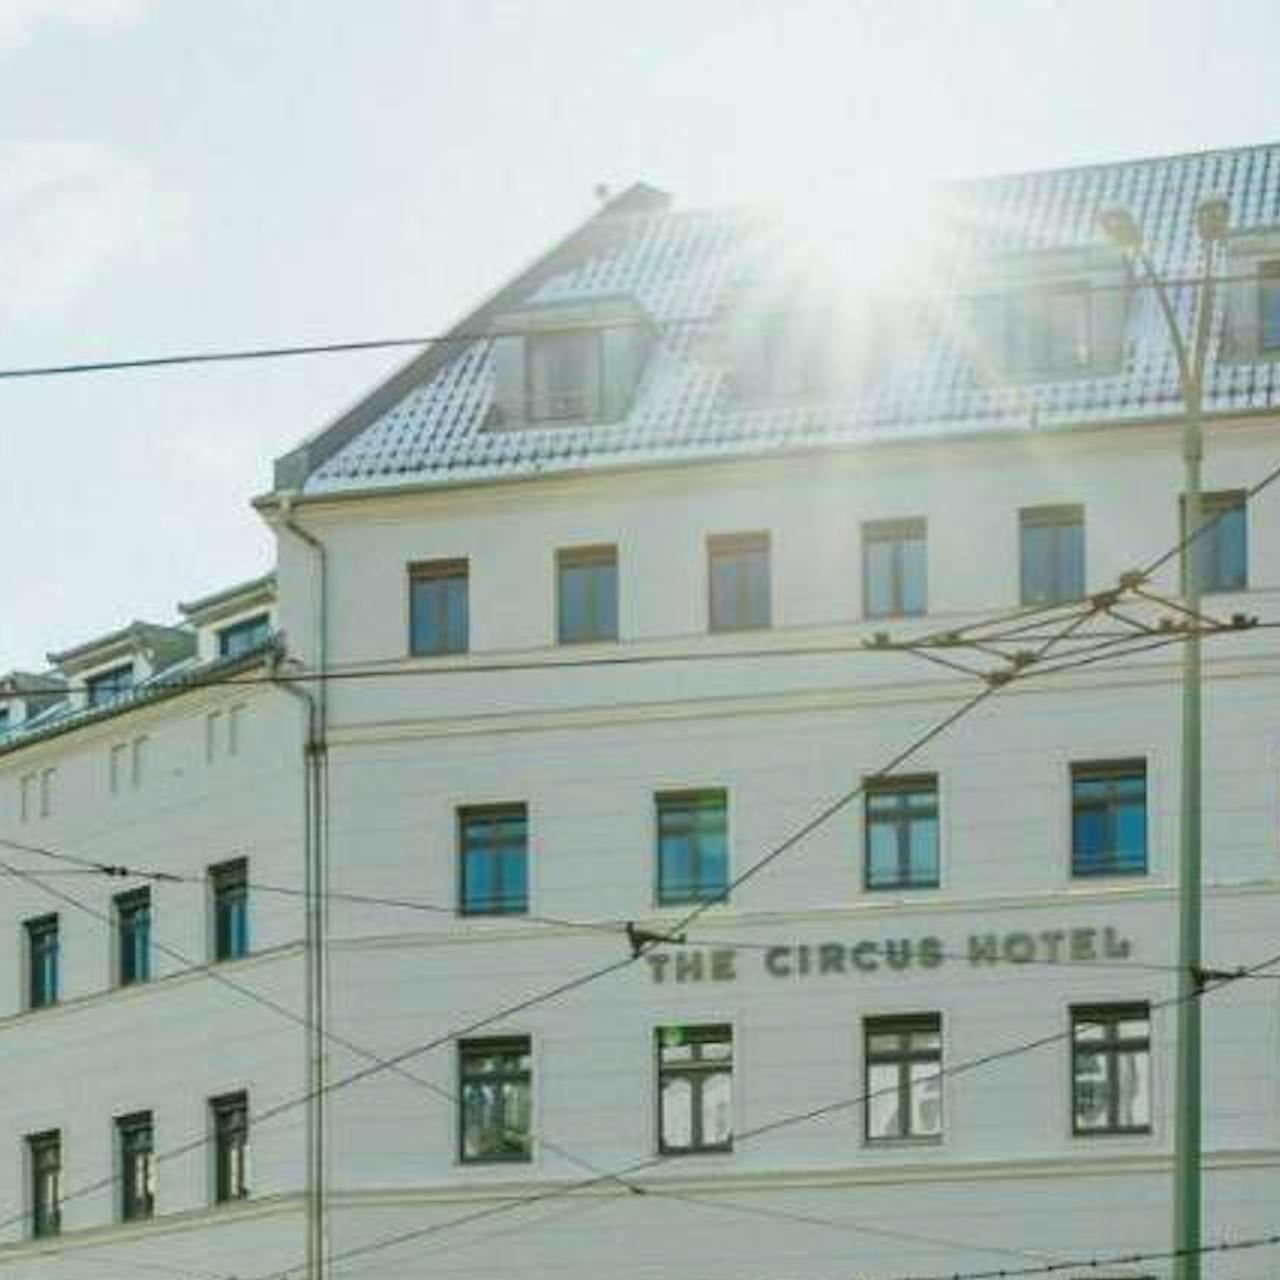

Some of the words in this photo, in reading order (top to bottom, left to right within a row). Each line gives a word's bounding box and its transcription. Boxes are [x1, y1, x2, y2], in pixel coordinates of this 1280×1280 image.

[646, 949, 737, 984] THE
[764, 935, 945, 978] CIRCUS
[967, 926, 1132, 967] HOTEL
